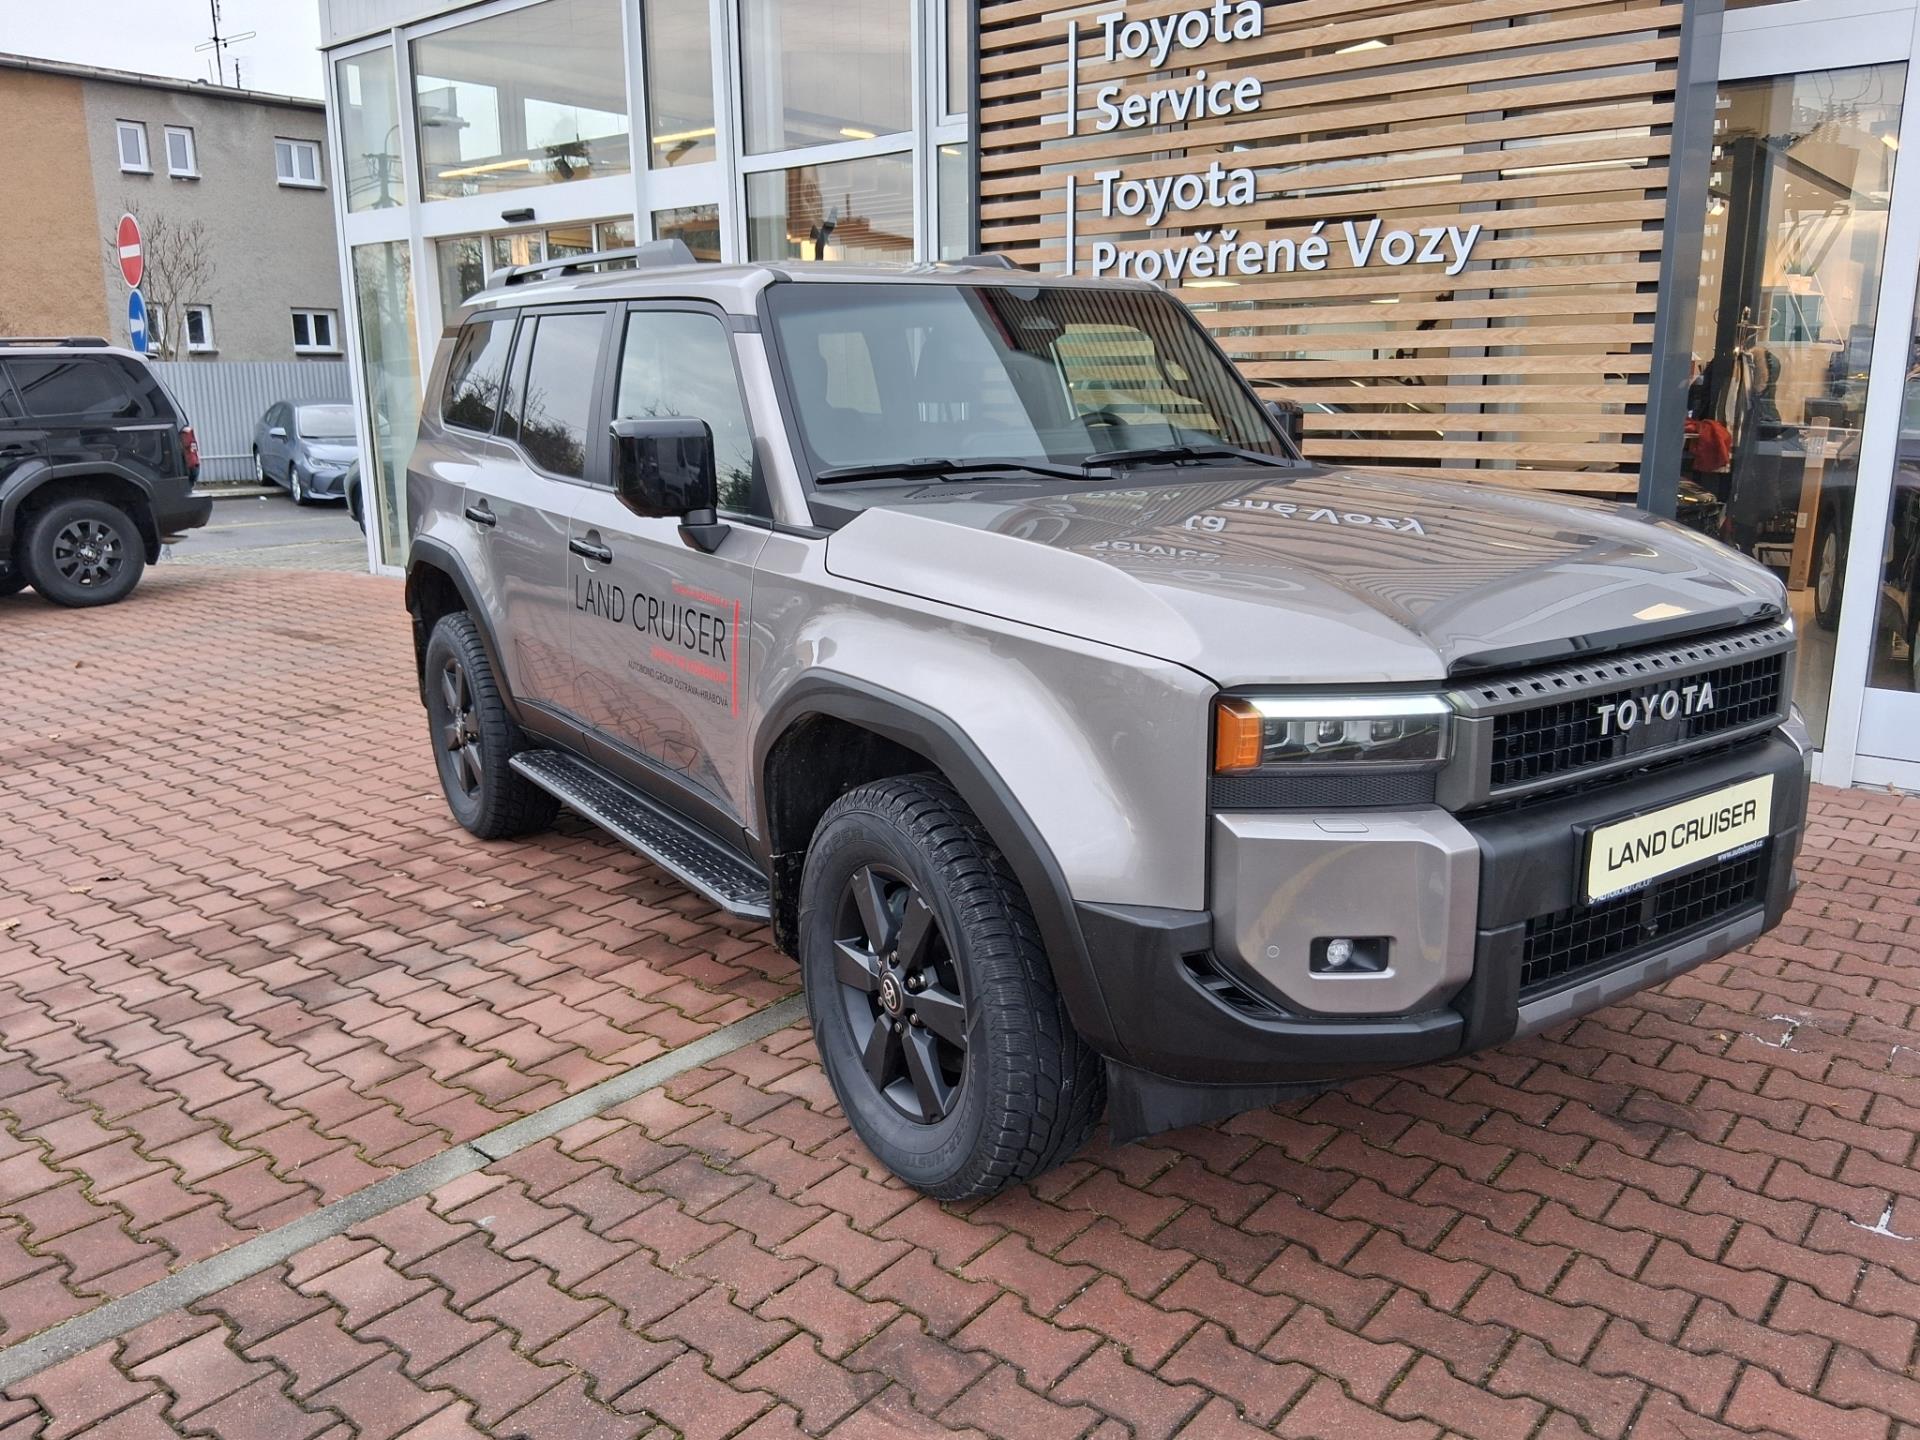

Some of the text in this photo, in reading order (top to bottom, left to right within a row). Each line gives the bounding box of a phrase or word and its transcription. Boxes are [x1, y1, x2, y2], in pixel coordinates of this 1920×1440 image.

[1096, 0, 1262, 68] Toyota
[1095, 69, 1263, 132] Service
[1094, 161, 1257, 226] Toyota
[1092, 219, 1482, 282] Prověřené Vozy
[575, 574, 727, 662] LAND CRUISER
[1597, 682, 1714, 735] TOYOTA
[1608, 799, 1757, 872] LAND CRUISER
